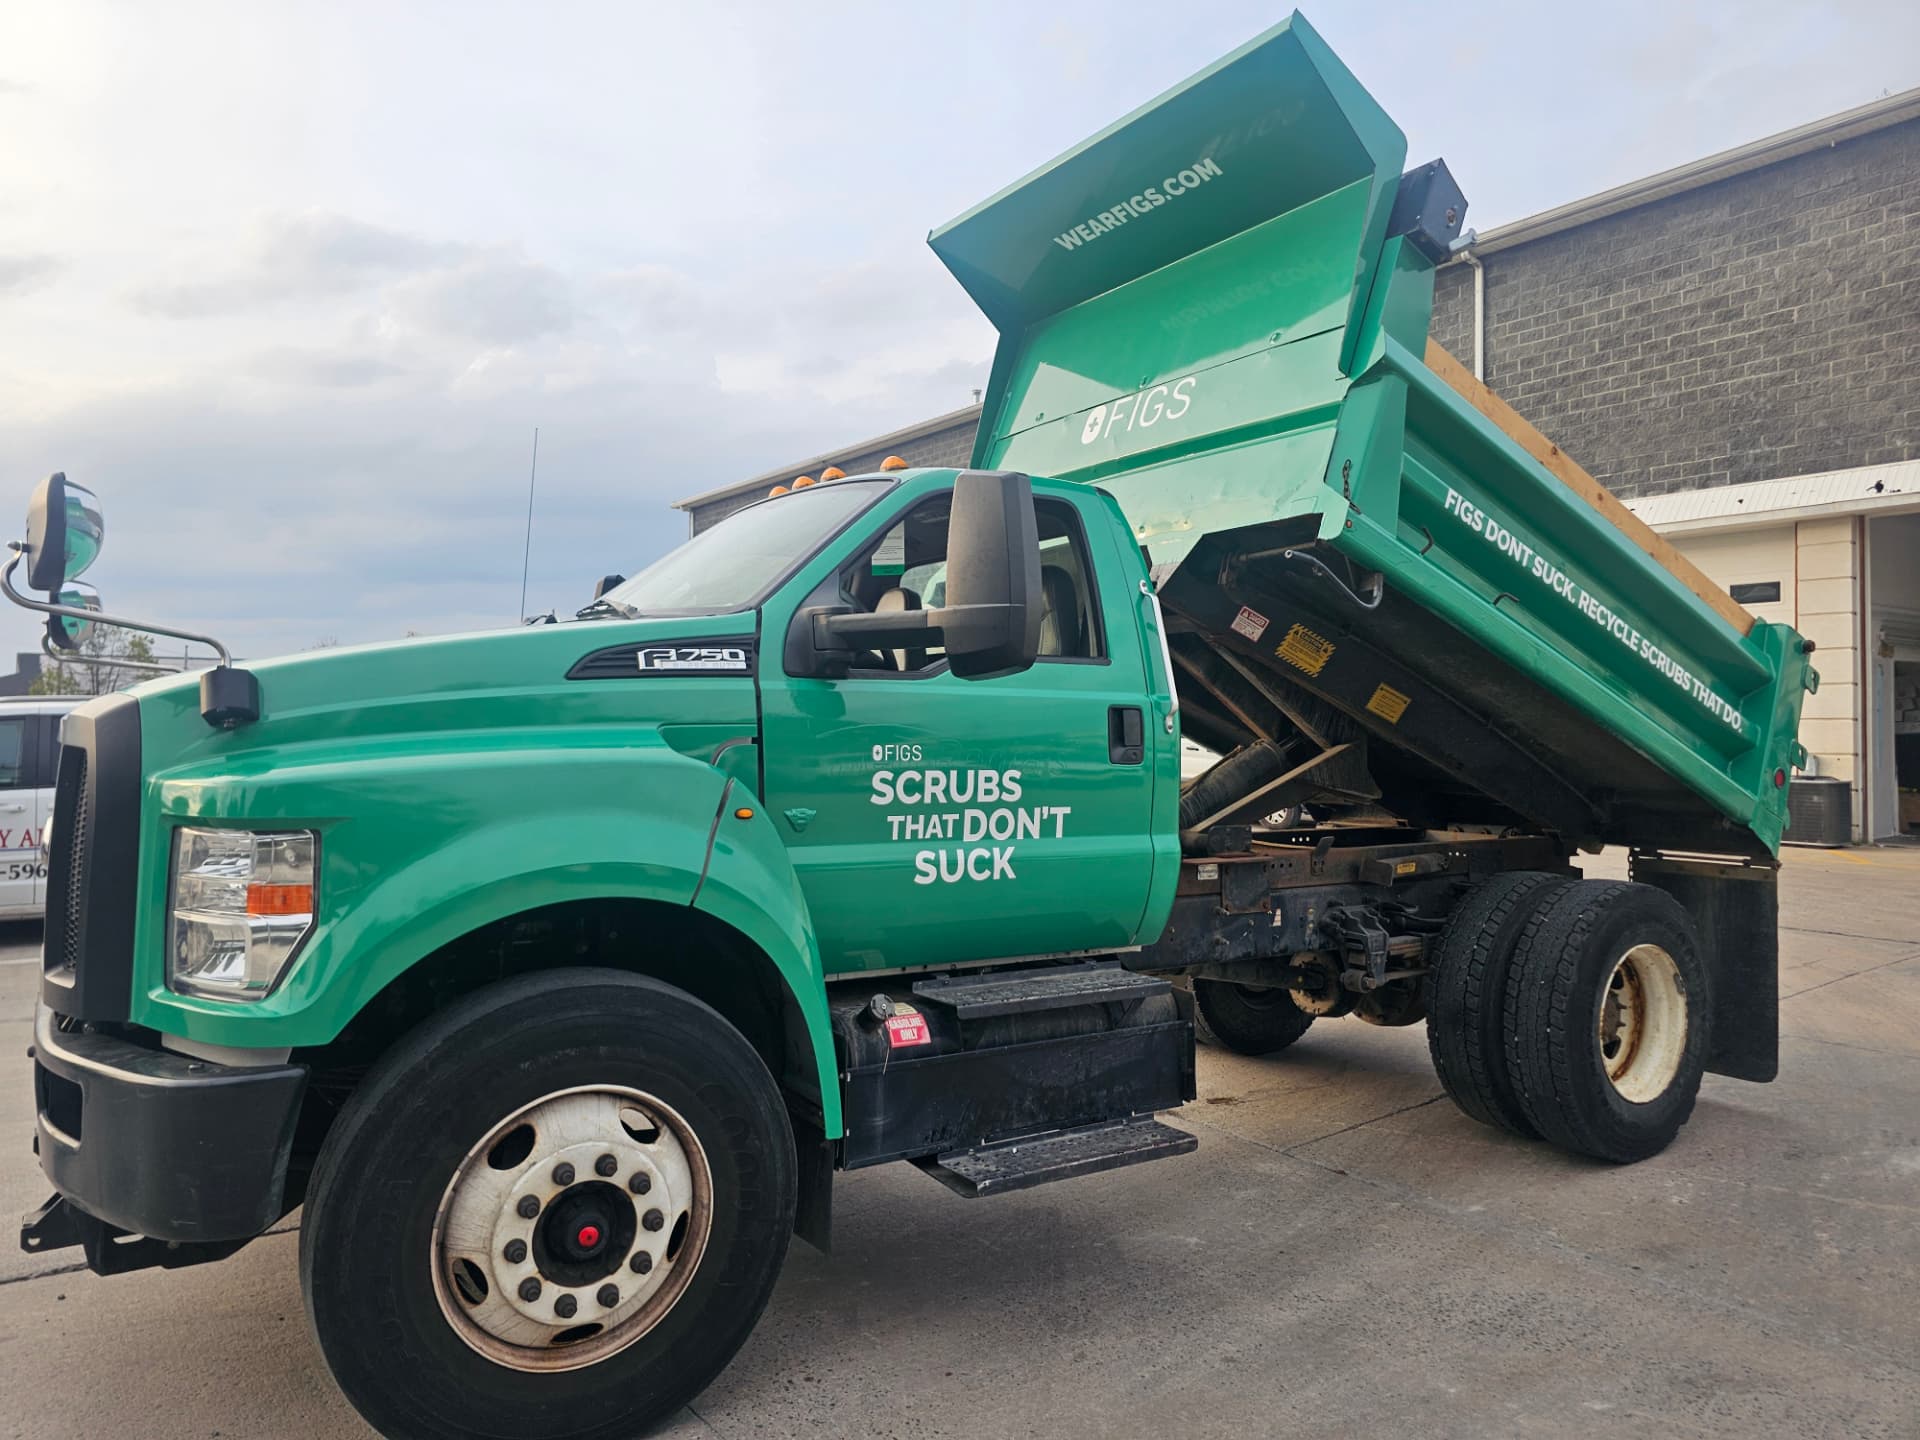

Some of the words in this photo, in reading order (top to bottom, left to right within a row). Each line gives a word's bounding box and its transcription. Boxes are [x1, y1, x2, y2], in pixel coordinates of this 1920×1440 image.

[1053, 157, 1223, 251] WEARFIGS.COM
[1103, 376, 1196, 439] FIGS
[1444, 487, 1486, 532] FIGS
[1577, 590, 1641, 652] RECYCLE
[1639, 639, 1692, 691] SCRUBS
[1692, 678, 1727, 714] THAT
[1722, 705, 1743, 733] DO.
[884, 744, 922, 761] FIGS
[870, 769, 1022, 805] SCRUBS
[887, 813, 959, 840] THAT
[963, 806, 1071, 842] DON'T
[914, 846, 1016, 885] SUCK
[901, 1028, 918, 1041] ONLY
